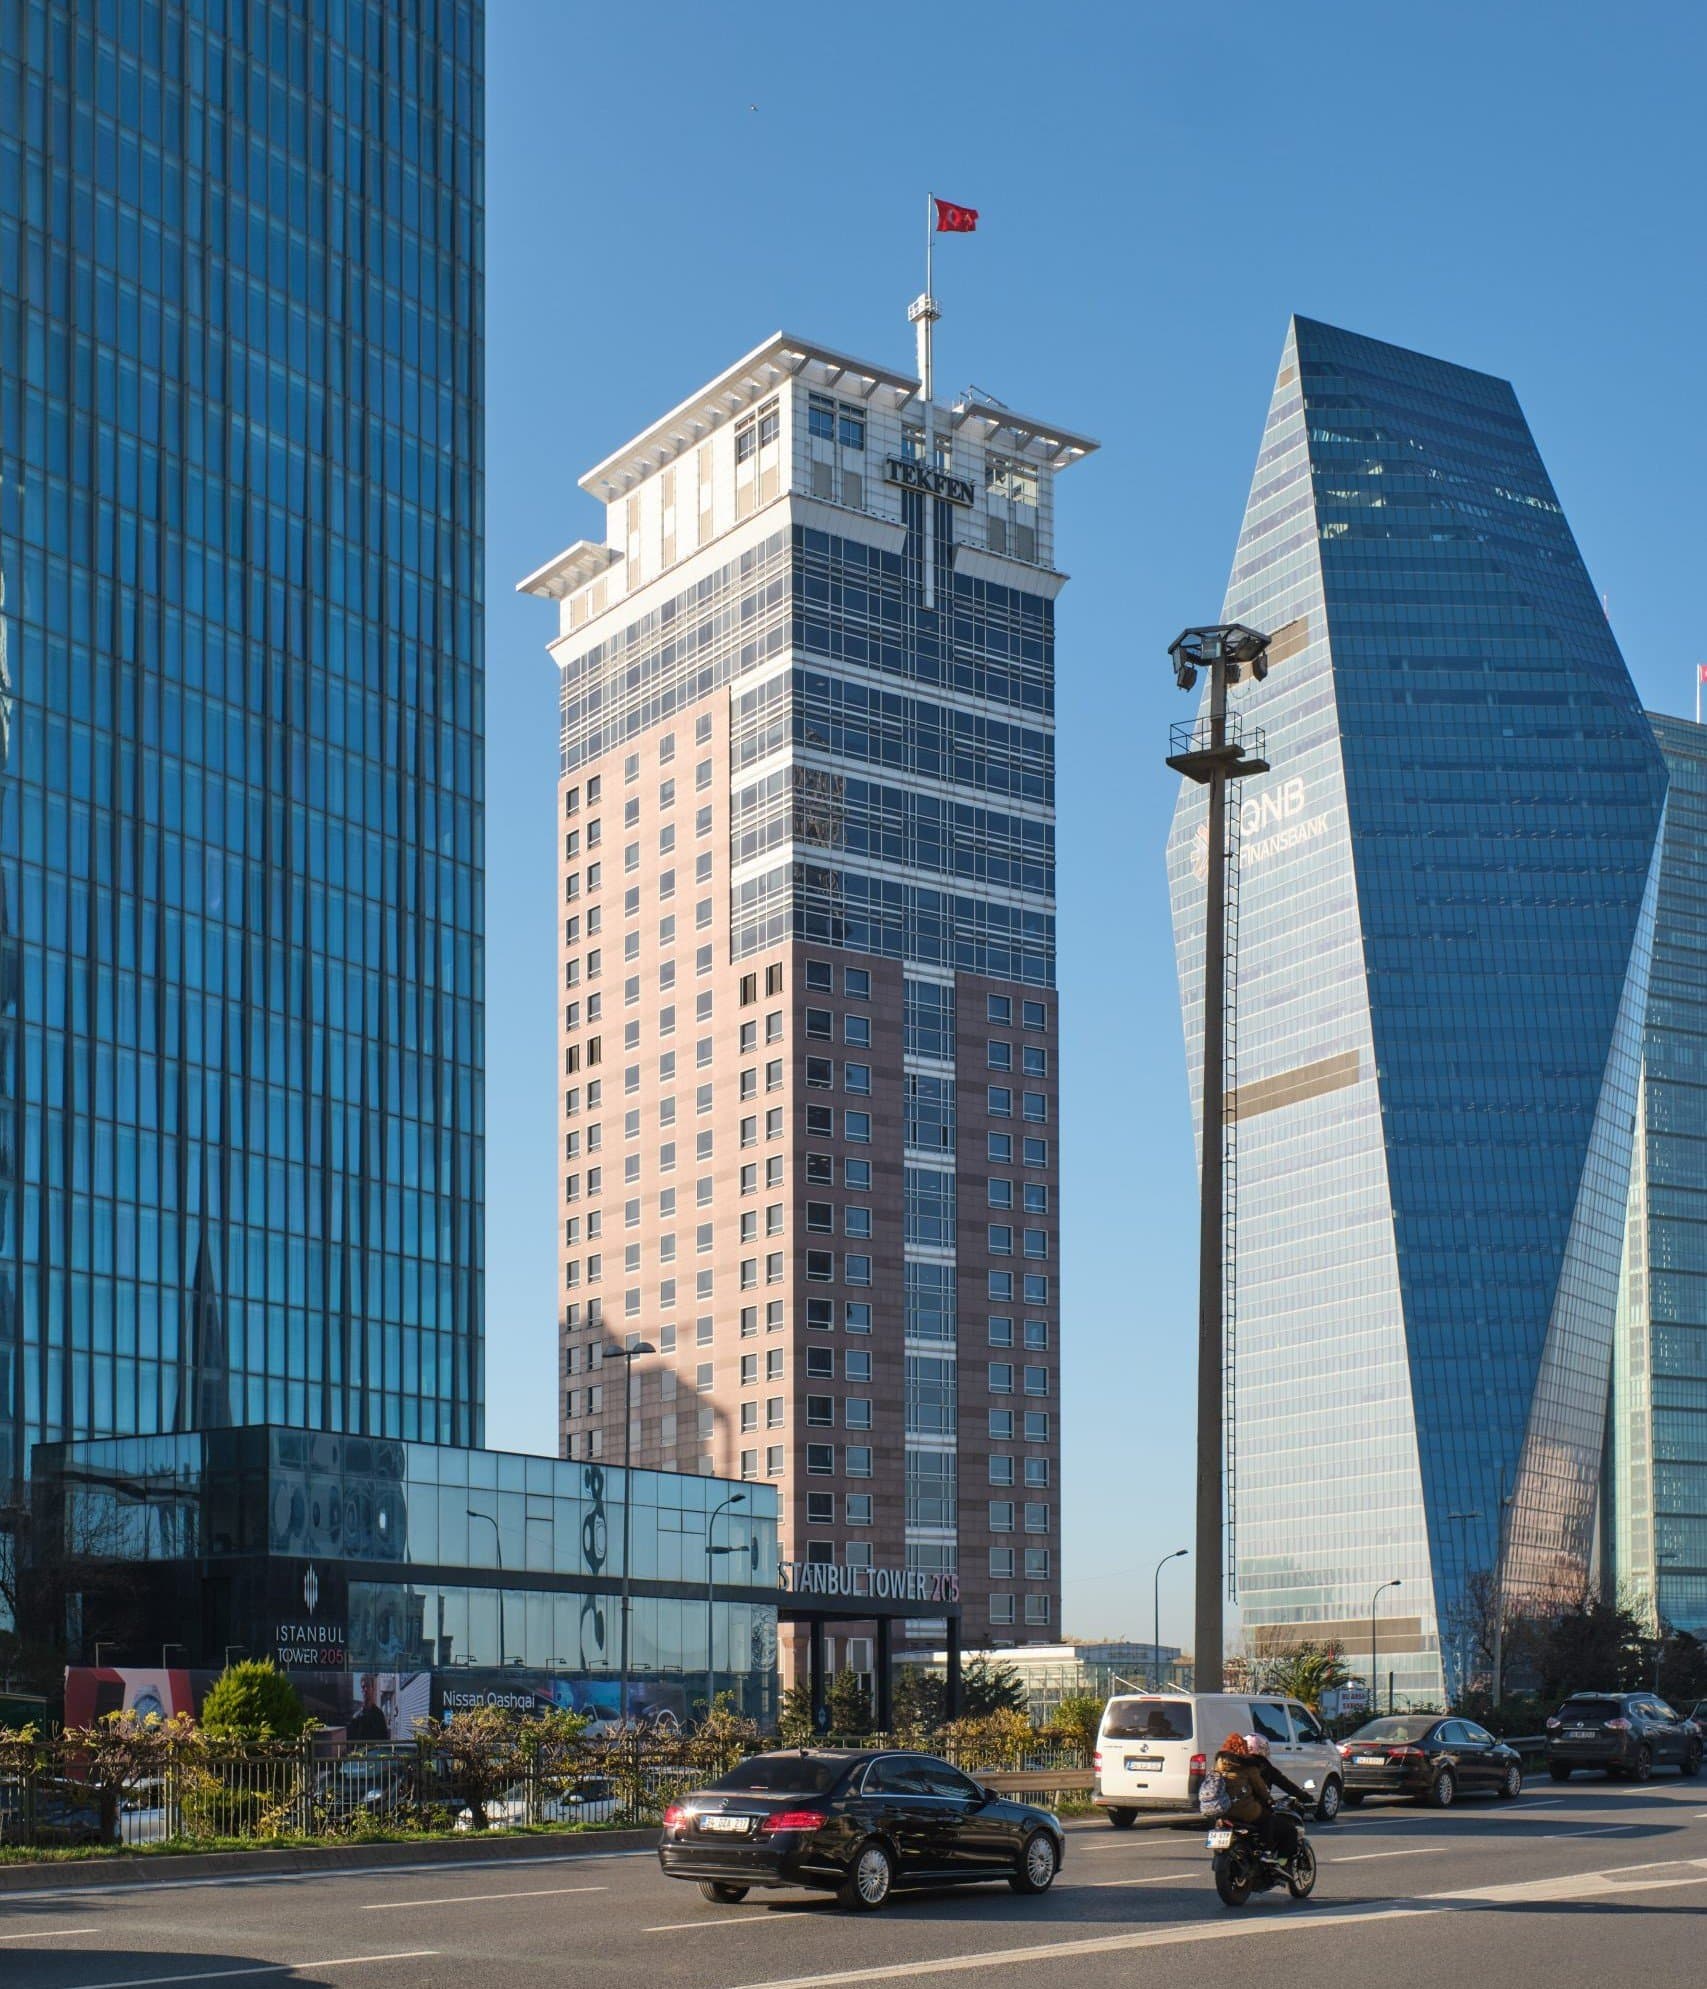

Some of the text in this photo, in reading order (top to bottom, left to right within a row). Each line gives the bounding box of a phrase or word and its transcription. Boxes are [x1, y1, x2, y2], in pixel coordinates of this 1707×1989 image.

[886, 459, 976, 504] TEKFEN
[1241, 777, 1305, 836] QNB
[1240, 813, 1329, 869] FINANSBANK
[779, 1561, 867, 1597] STANBUL
[866, 1568, 927, 1601] TOWER
[275, 1625, 345, 1643] ISTANBUL
[278, 1648, 344, 1665] TOWER 205
[443, 1690, 536, 1712] Nissan Qashqai
